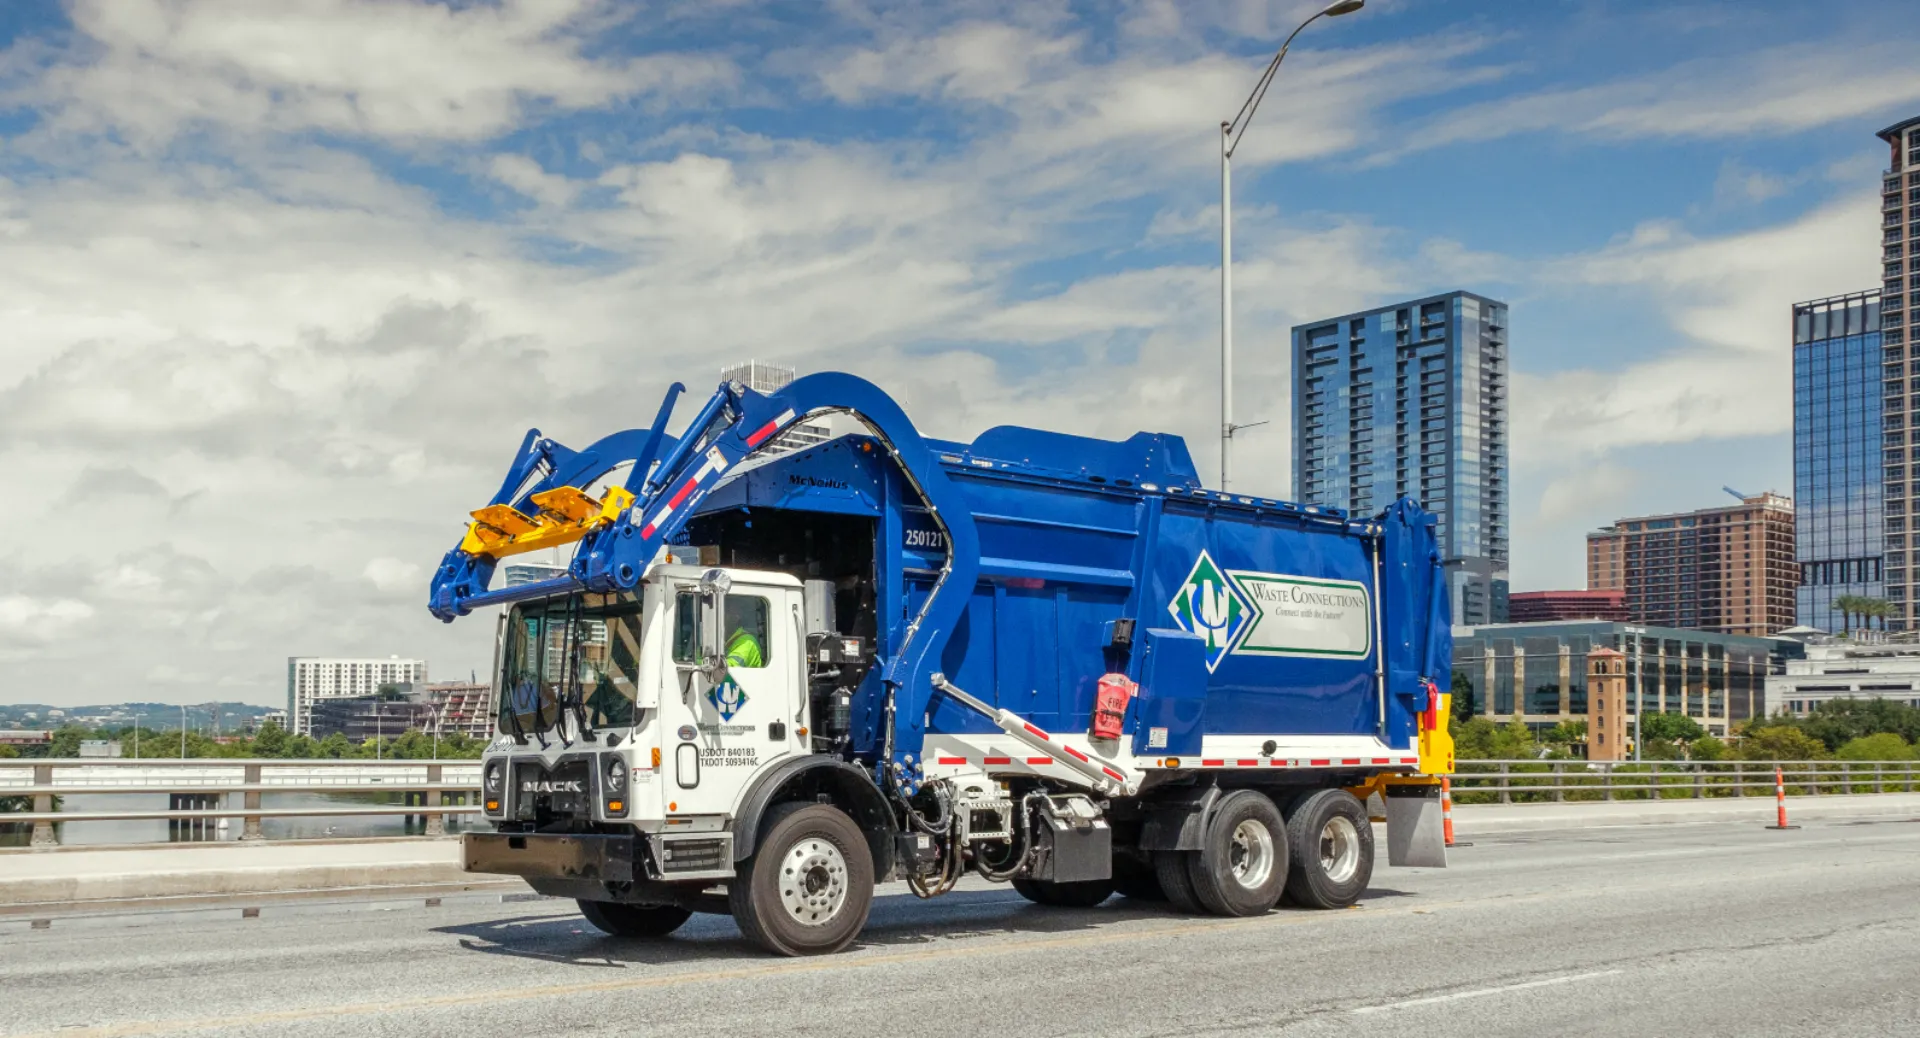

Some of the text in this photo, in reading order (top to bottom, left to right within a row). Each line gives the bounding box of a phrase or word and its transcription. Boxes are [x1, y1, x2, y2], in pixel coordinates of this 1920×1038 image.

[789, 474, 849, 490] McNeilus
[905, 529, 942, 547] 250121
[1251, 582, 1365, 608] WASTE CONNECTIONS
[1107, 697, 1123, 710] FIRE
[699, 747, 726, 757] USDOT
[700, 757, 724, 767] TXDOT
[522, 780, 582, 793] MACK
